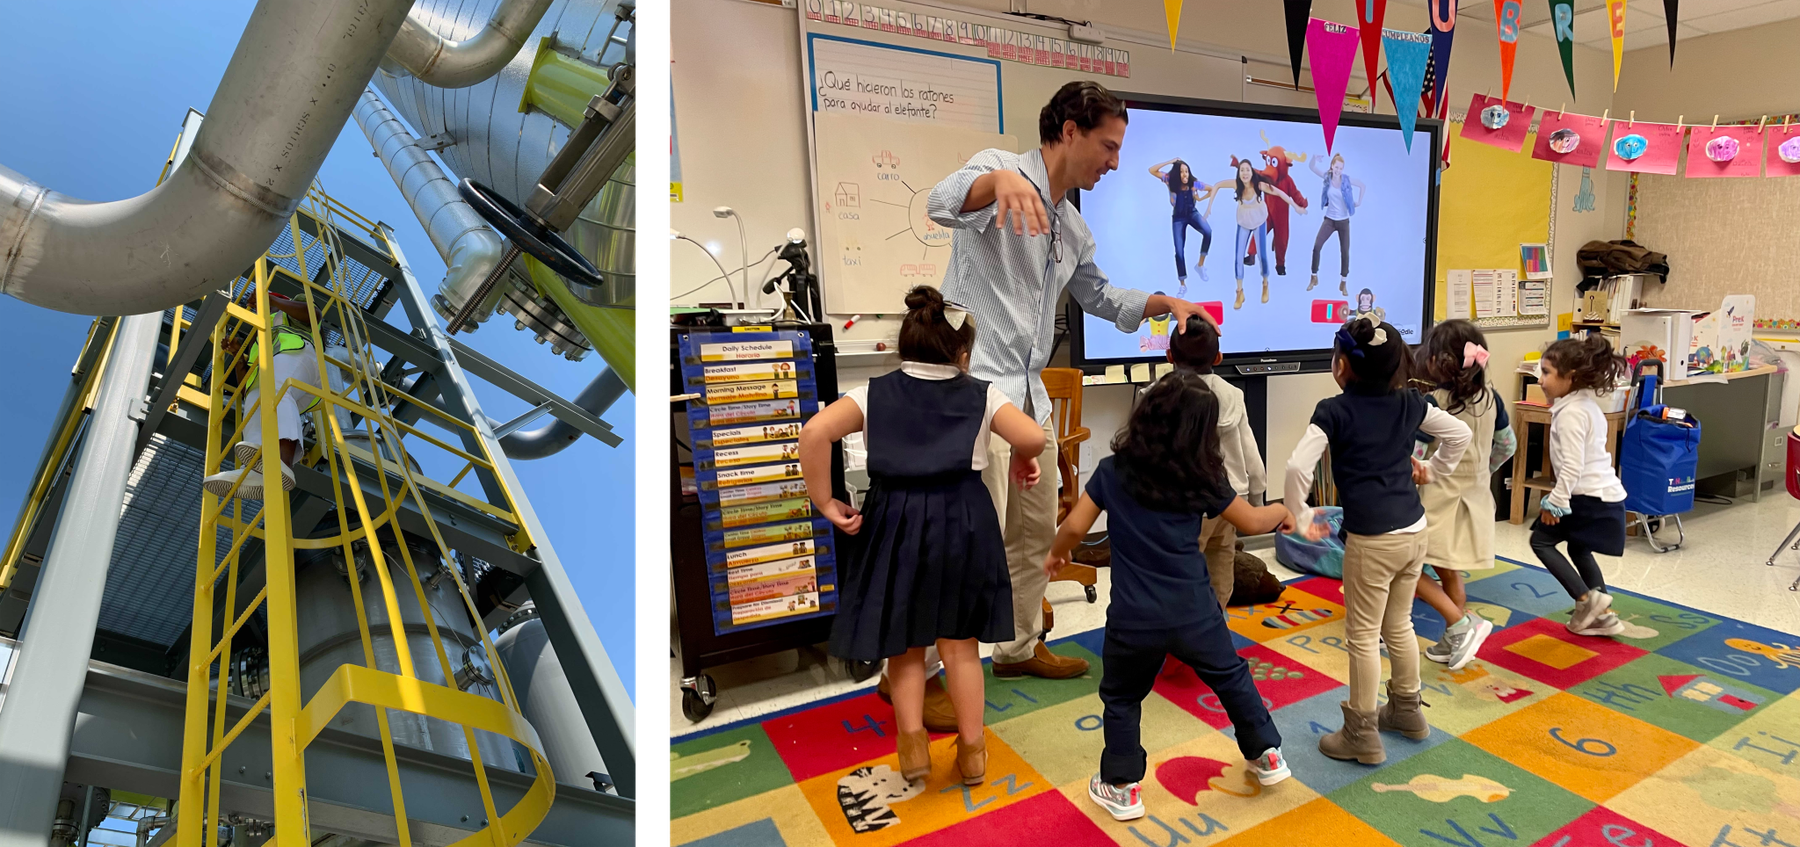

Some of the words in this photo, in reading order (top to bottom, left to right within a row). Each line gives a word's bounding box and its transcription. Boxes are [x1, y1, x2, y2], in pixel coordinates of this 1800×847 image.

[1324, 22, 1346, 33] FELIZ
[1500, 2, 1520, 43] B
[1554, 3, 1574, 43] R
[1612, 1, 1623, 38] E
[810, 0, 821, 13] 0
[831, 0, 838, 16] 1
[846, 3, 855, 19] 2
[865, 6, 875, 22] 3
[881, 9, 891, 25] 4
[897, 12, 907, 27] 5
[914, 13, 923, 30] 6
[931, 17, 940, 33] 7
[945, 19, 953, 35] 8
[960, 22, 968, 38] 9
[974, 24, 985, 40] 10
[1003, 29, 1014, 45] 12
[1019, 33, 1032, 48] 13
[1035, 35, 1045, 51] 14
[1051, 38, 1062, 53] 15
[1106, 47, 1114, 62] 19
[818, 71, 851, 97] ¿Qué
[900, 79, 914, 99] los
[918, 83, 954, 104] ratones
[823, 98, 846, 111] para
[851, 98, 881, 114] ayudar
[884, 101, 892, 113] al
[895, 102, 938, 119] elefante?
[877, 172, 900, 181] carro
[838, 211, 860, 220] casa
[842, 255, 862, 266] taxi
[705, 366, 737, 374] Breakfast
[736, 384, 766, 392] Message
[713, 430, 741, 438] Specials
[727, 552, 747, 560] Lunch
[1511, 582, 1557, 599] 2
[842, 714, 887, 737] 4
[1548, 727, 1617, 757] 6
[939, 773, 1034, 813] Zz
